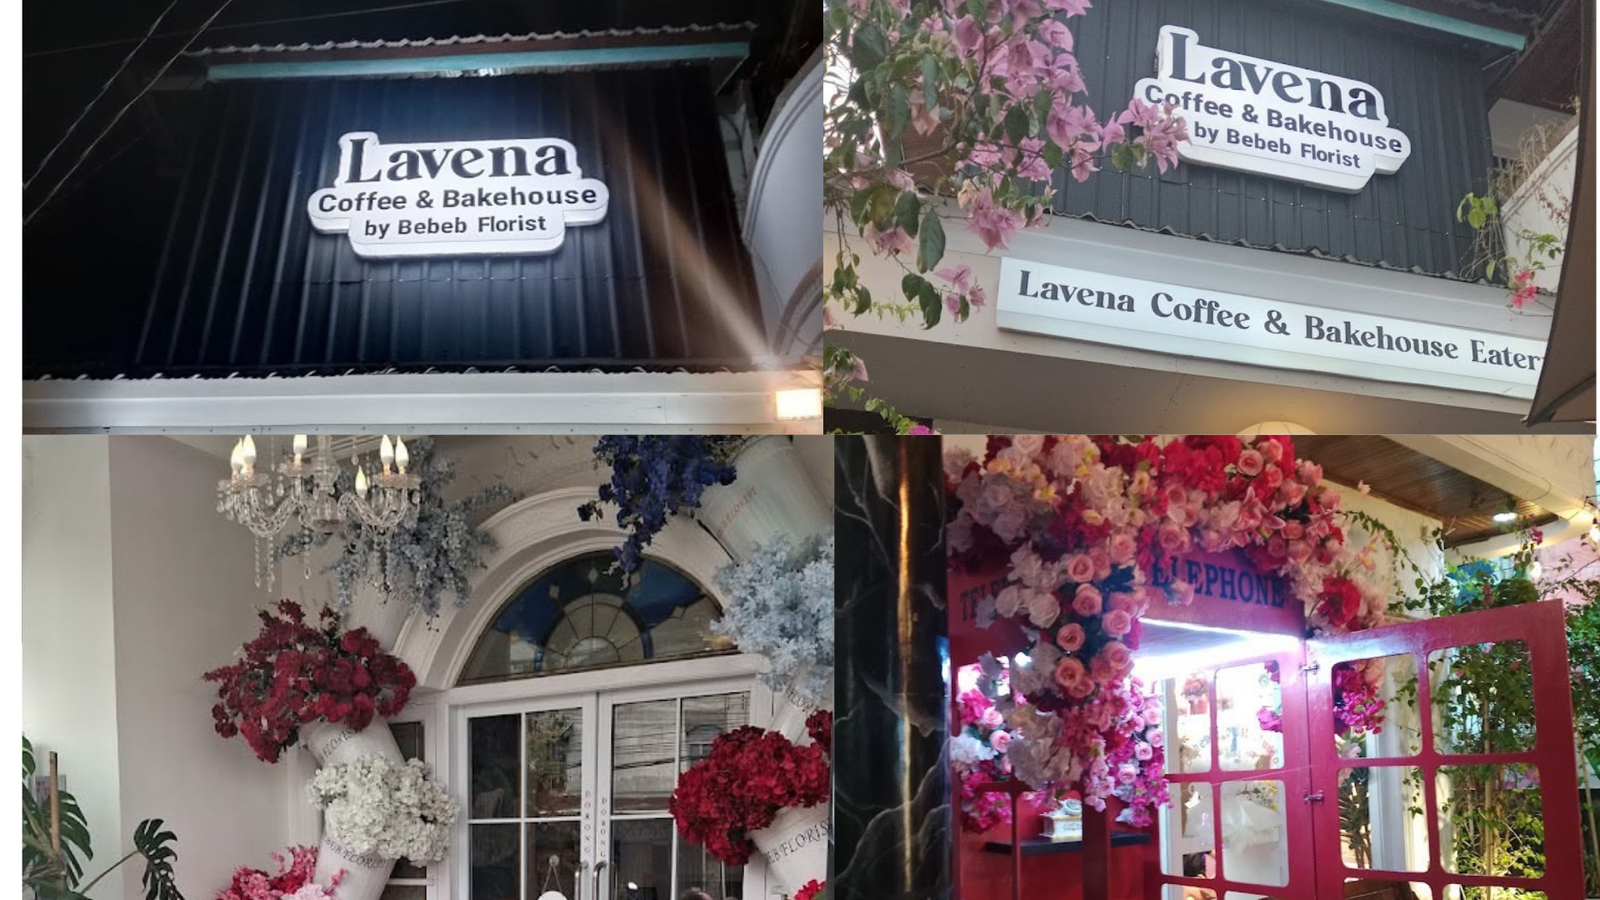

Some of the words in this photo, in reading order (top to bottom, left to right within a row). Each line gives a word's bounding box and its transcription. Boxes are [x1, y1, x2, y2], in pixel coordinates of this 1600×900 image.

[1169, 32, 1381, 121] Lavena
[1144, 84, 1234, 118] Coffee
[1242, 103, 1259, 124] &
[1267, 108, 1402, 153] Bakehouse
[345, 138, 572, 183] Lavena
[1194, 121, 1219, 144] by
[1226, 128, 1292, 155] Bebeb
[1300, 143, 1361, 168] Florist
[318, 192, 407, 212] Coffee
[416, 190, 434, 208] &
[443, 186, 597, 208] Bakehouse
[364, 219, 390, 239] by
[398, 217, 467, 235] Bebeb
[478, 215, 547, 232] Florist
[1018, 270, 1135, 312] Lavena
[1151, 292, 1250, 330] Coffee
[1264, 310, 1291, 336] &
[1305, 315, 1459, 359] Bakehouse
[1470, 339, 1545, 370] Eater
[1152, 553, 1285, 608] EEPHONE
